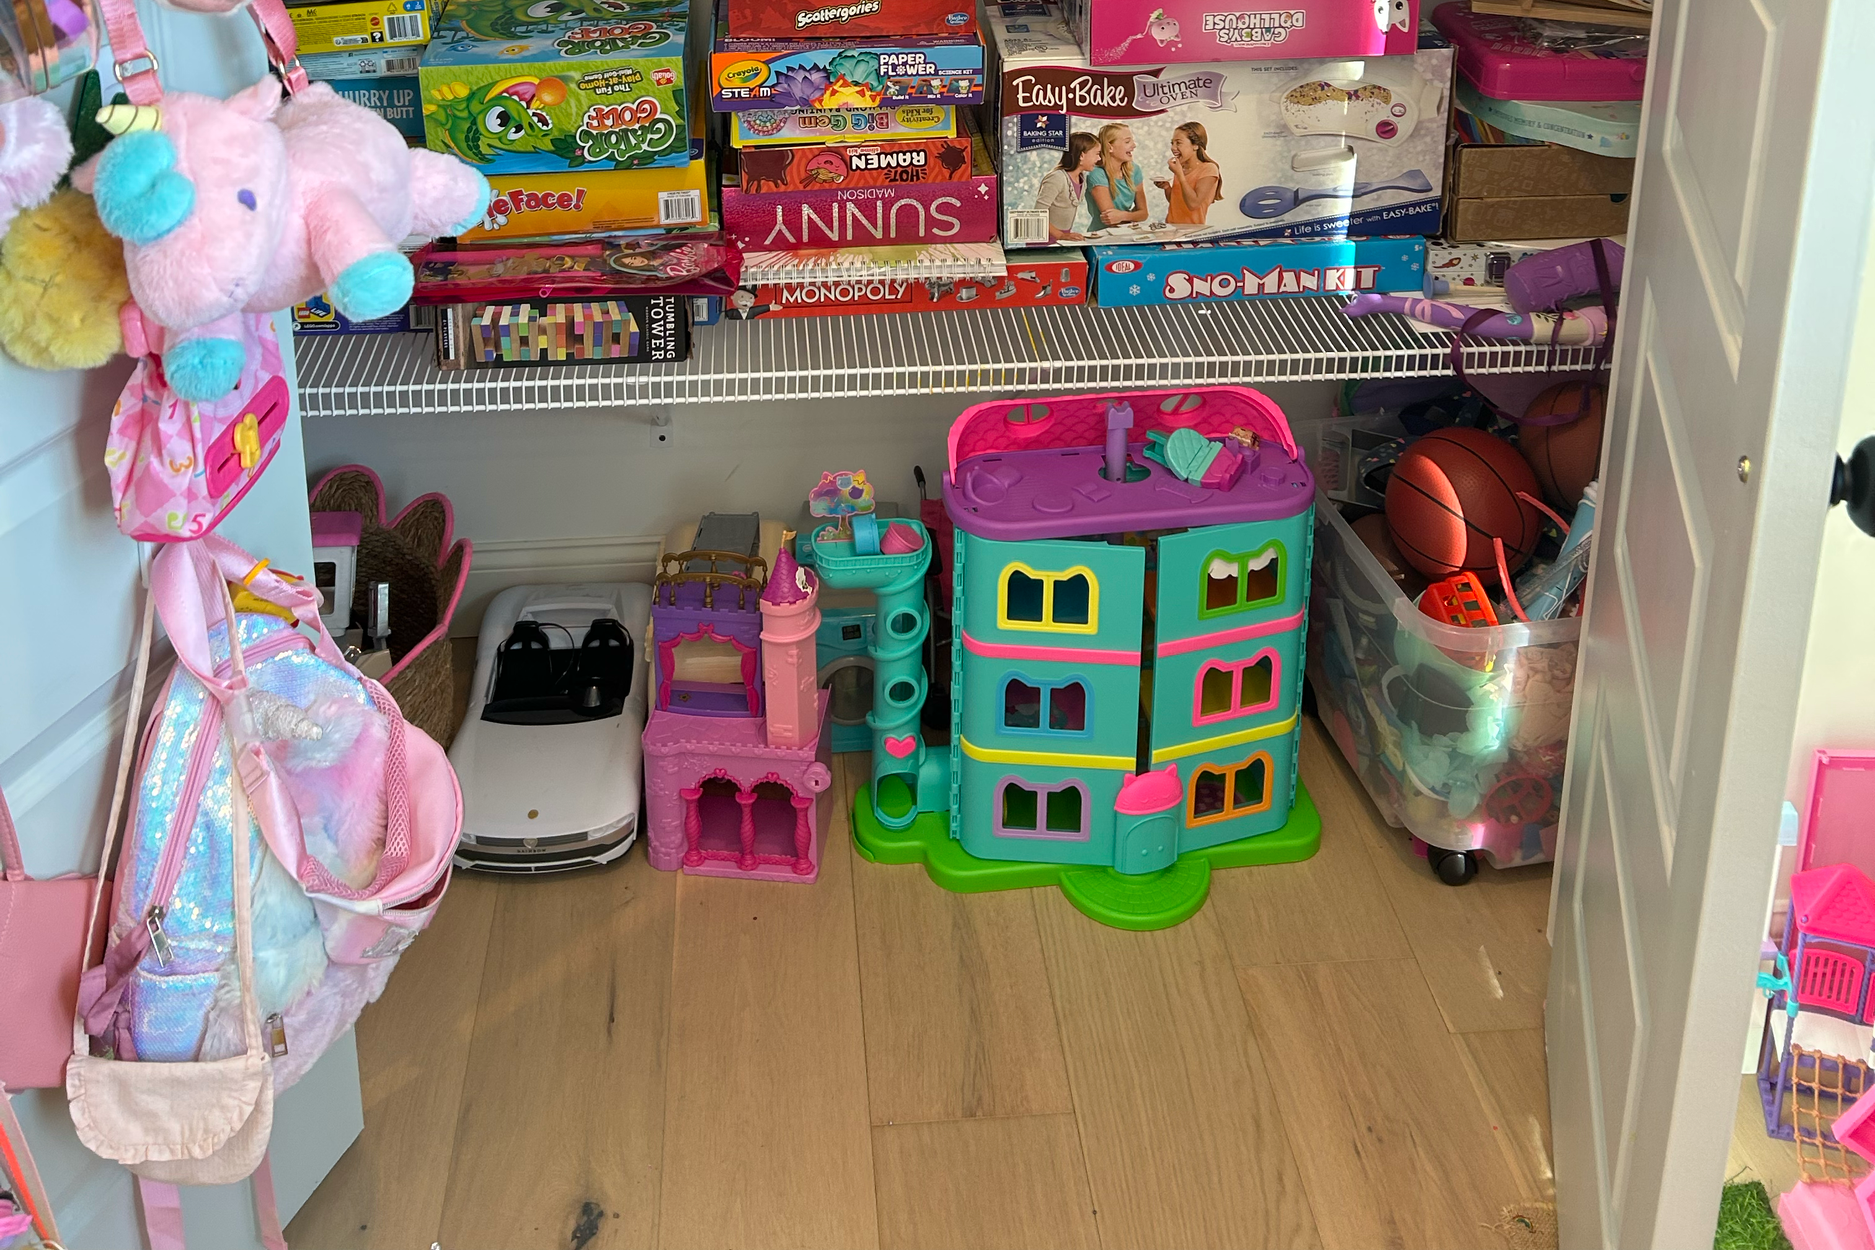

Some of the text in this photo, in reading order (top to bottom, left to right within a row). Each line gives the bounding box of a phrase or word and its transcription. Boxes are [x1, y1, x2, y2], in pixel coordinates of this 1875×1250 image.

[1204, 11, 1304, 31] DOLLHOUSE
[567, 22, 655, 41] GOLF
[1217, 28, 1288, 43] GABBY'S
[556, 31, 672, 57] GATOR
[880, 53, 925, 65] PAPER
[726, 65, 760, 80] Crayola
[595, 83, 631, 95] The Fun
[721, 86, 772, 98] STEAM
[1142, 75, 1213, 99] Ultimate
[394, 89, 414, 106] UP
[1159, 89, 1200, 105] OVEN
[387, 107, 415, 119] BUTT
[586, 99, 658, 131] GOLF
[900, 115, 941, 124] Creativity
[902, 108, 924, 116] Kids
[578, 117, 675, 160] GATOR
[851, 151, 926, 170] RAMEN
[889, 169, 921, 183] HOT
[507, 187, 587, 213] Face!
[837, 188, 895, 200] MADISON
[763, 196, 962, 245] SUNNY
[1294, 225, 1312, 235] Life
[1314, 223, 1321, 232] is
[1323, 215, 1364, 231] sweeter
[1366, 214, 1381, 223] with
[1114, 261, 1133, 272] IDEAL
[1324, 265, 1381, 291] KIT
[782, 283, 907, 305] MONOPOLY
[650, 296, 665, 361] TOWER
[665, 296, 676, 359] TUMBLING
